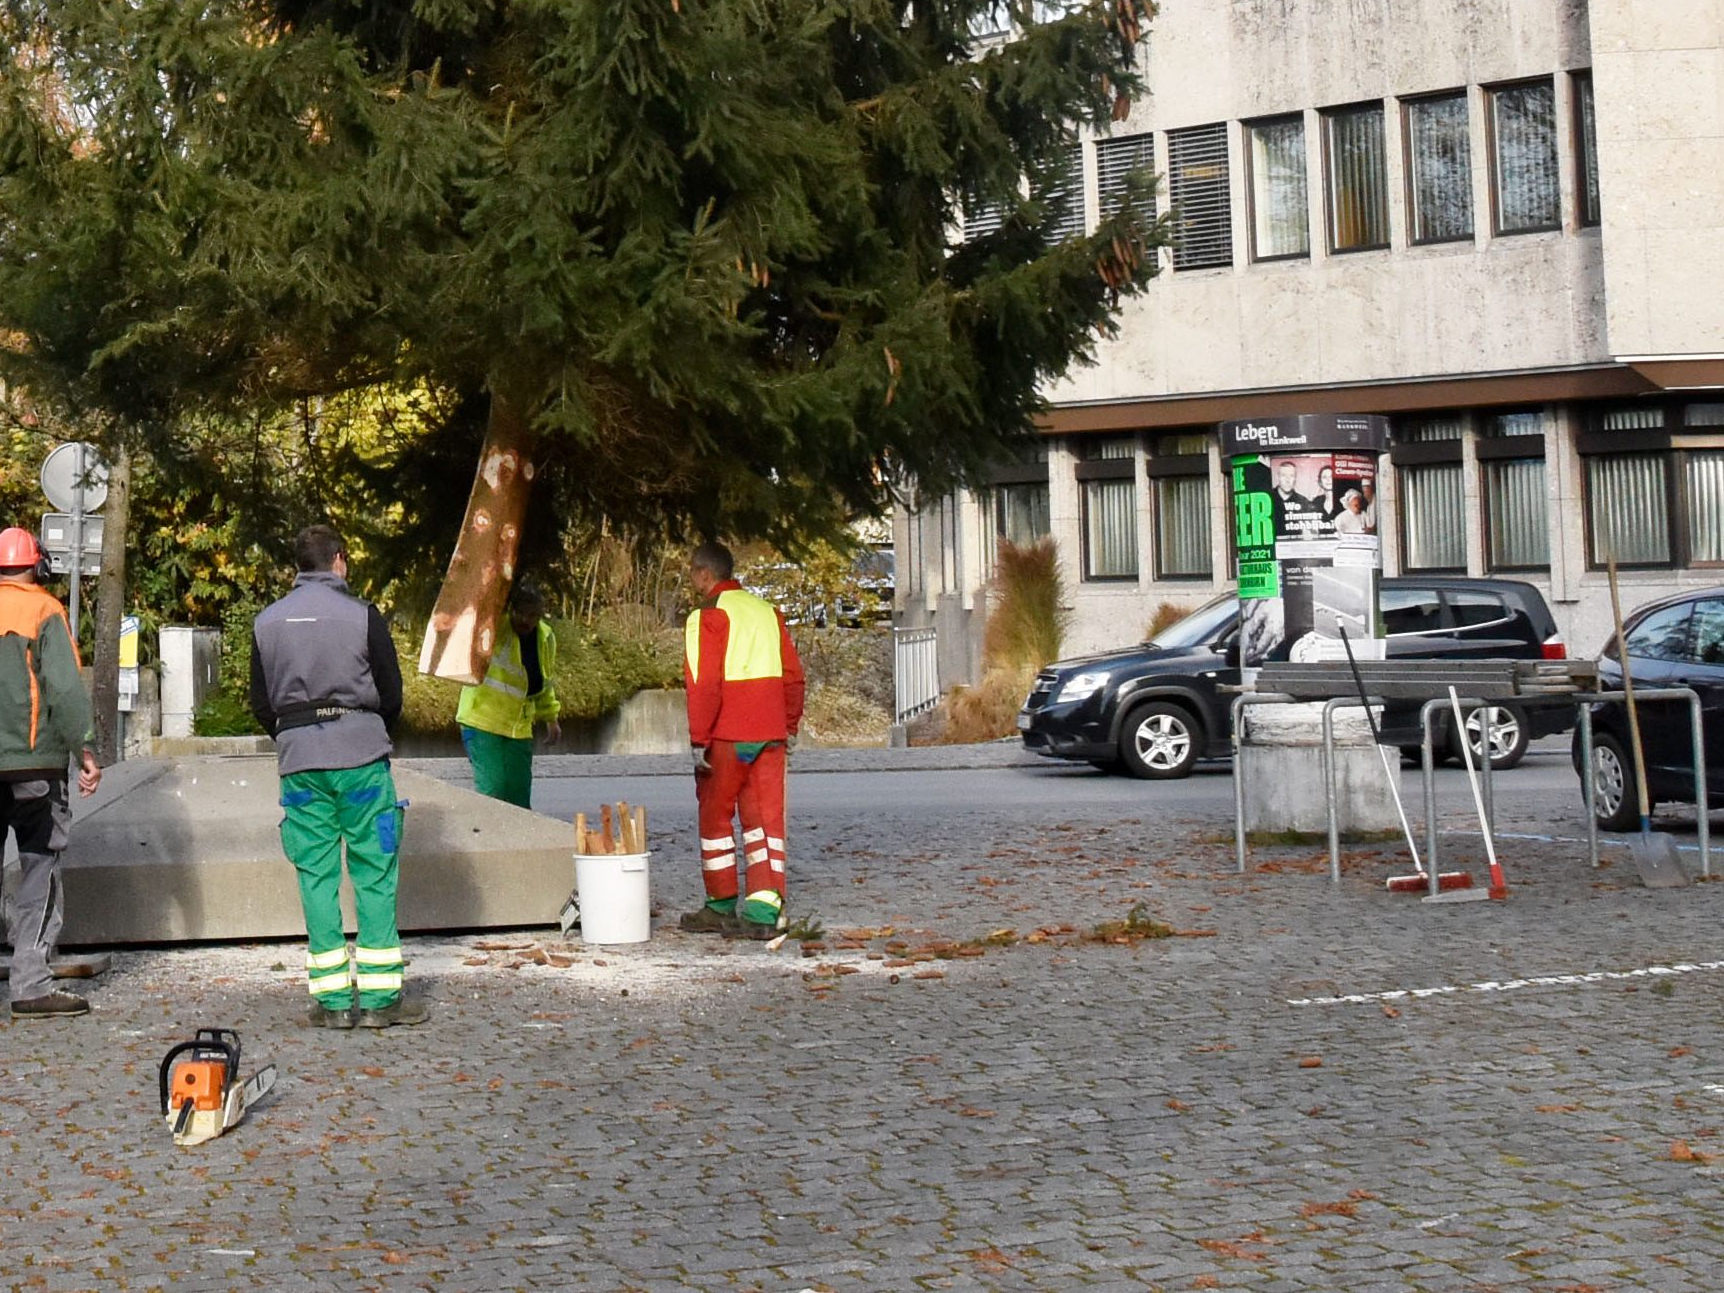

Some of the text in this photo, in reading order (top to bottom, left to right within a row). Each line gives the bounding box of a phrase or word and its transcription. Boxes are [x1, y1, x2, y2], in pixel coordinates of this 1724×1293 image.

[1236, 424, 1278, 441] Leben
[1259, 435, 1307, 446] in Rankweil
[1284, 502, 1302, 511] Wo
[1251, 549, 1271, 559] 2021
